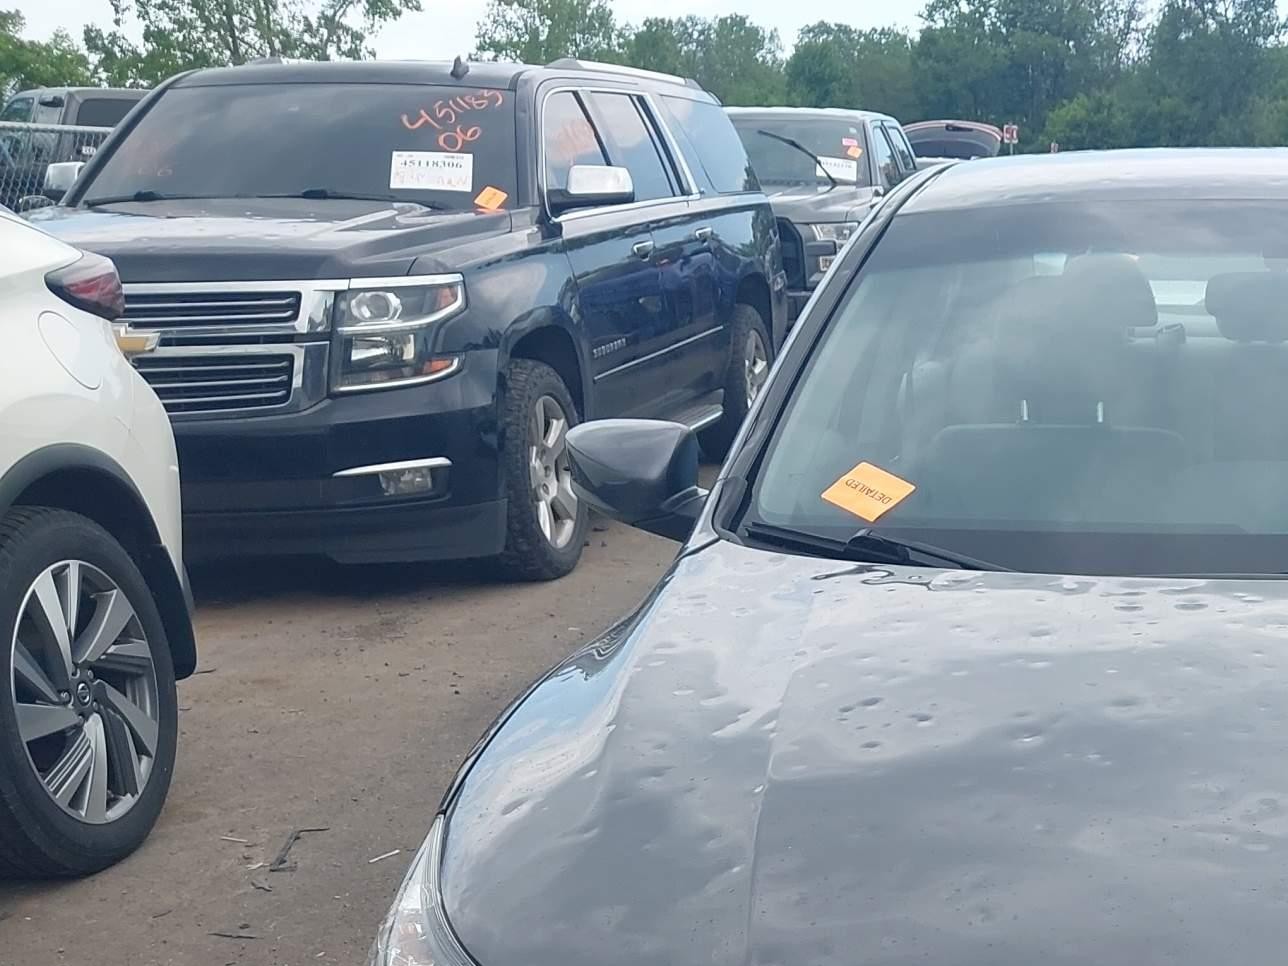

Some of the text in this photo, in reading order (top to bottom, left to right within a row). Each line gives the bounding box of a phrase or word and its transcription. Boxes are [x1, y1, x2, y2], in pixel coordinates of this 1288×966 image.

[438, 125, 482, 152] 06
[400, 159, 463, 169] 45118306
[845, 478, 893, 505] DETAILED
